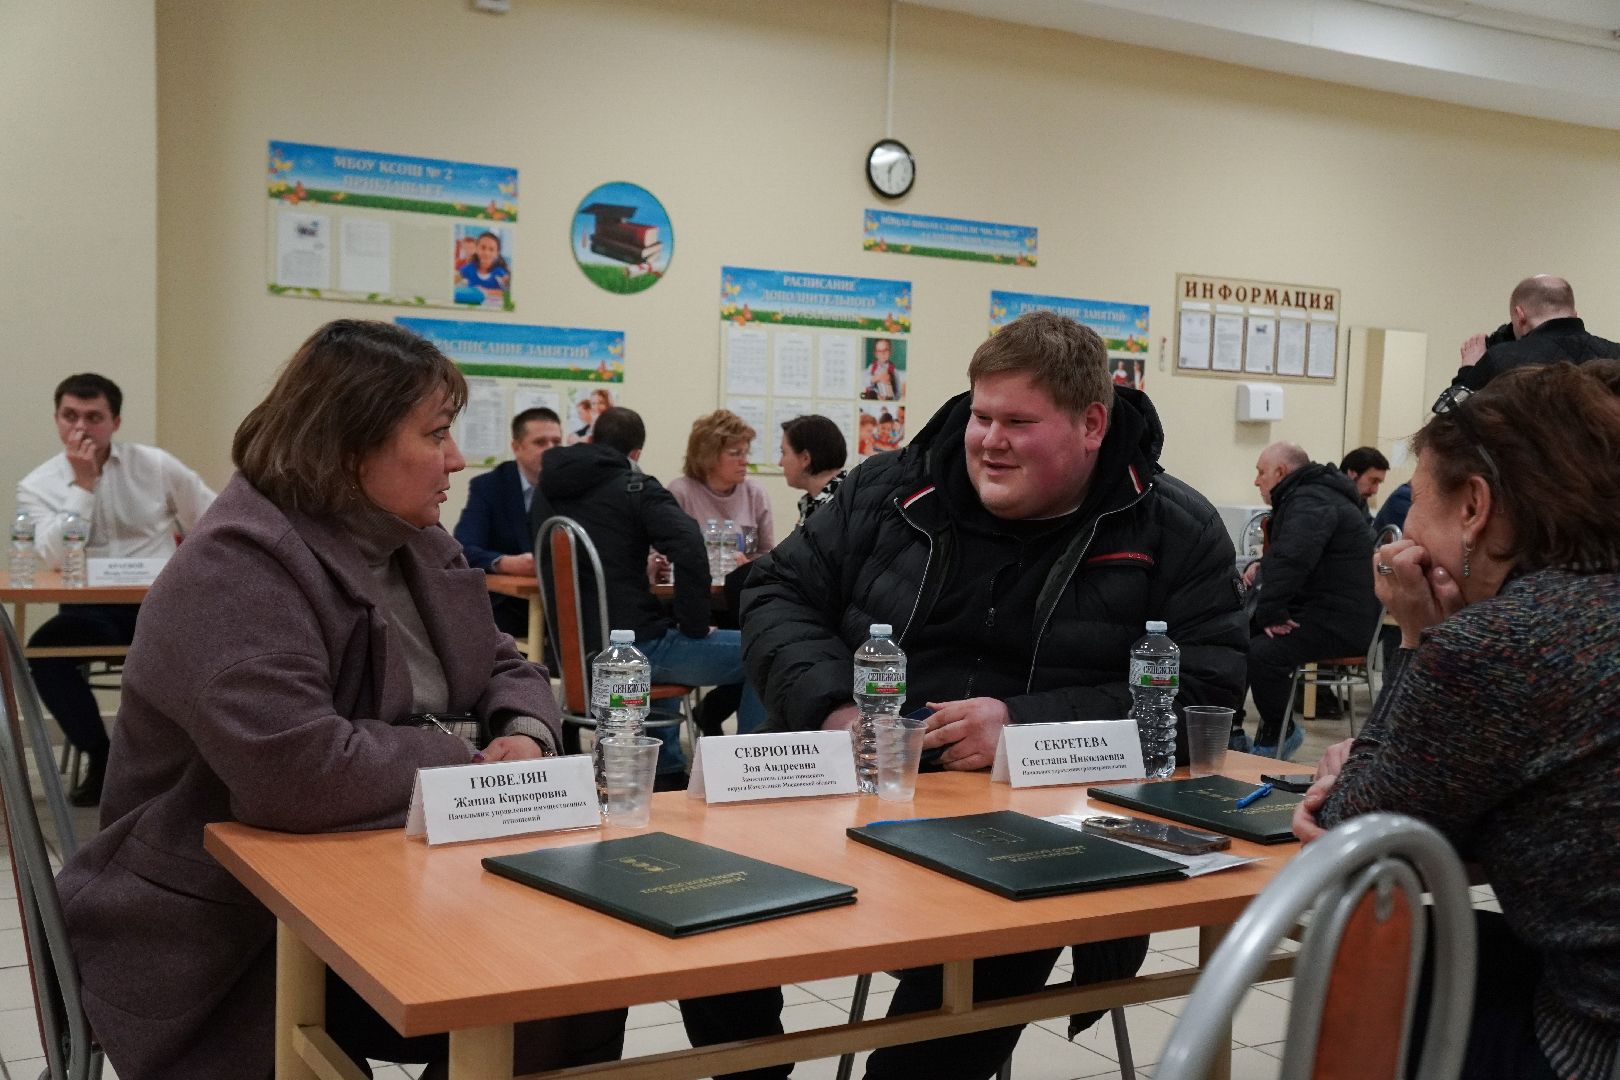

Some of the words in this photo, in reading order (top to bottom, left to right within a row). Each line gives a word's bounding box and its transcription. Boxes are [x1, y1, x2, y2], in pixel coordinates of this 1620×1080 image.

[334, 156, 375, 171] МБОУ
[444, 168, 454, 181] 2
[783, 275, 857, 292] РАСПИСАНИЕ
[1185, 281, 1334, 311] ИНФОРМАЦИЯ
[734, 744, 820, 759] СЕВРЮГИНА
[1034, 736, 1108, 751] СЕКРЕТЕВА
[743, 763, 761, 773] Зоя
[764, 762, 816, 774] Андреевна
[1021, 757, 1068, 767] Светлана
[1069, 753, 1125, 764] Николаевна
[469, 770, 548, 789] ГЮВЕЛЯН
[453, 796, 496, 809] Жанна
[499, 789, 568, 804] Киркоровна
[448, 811, 490, 821] Начальник
